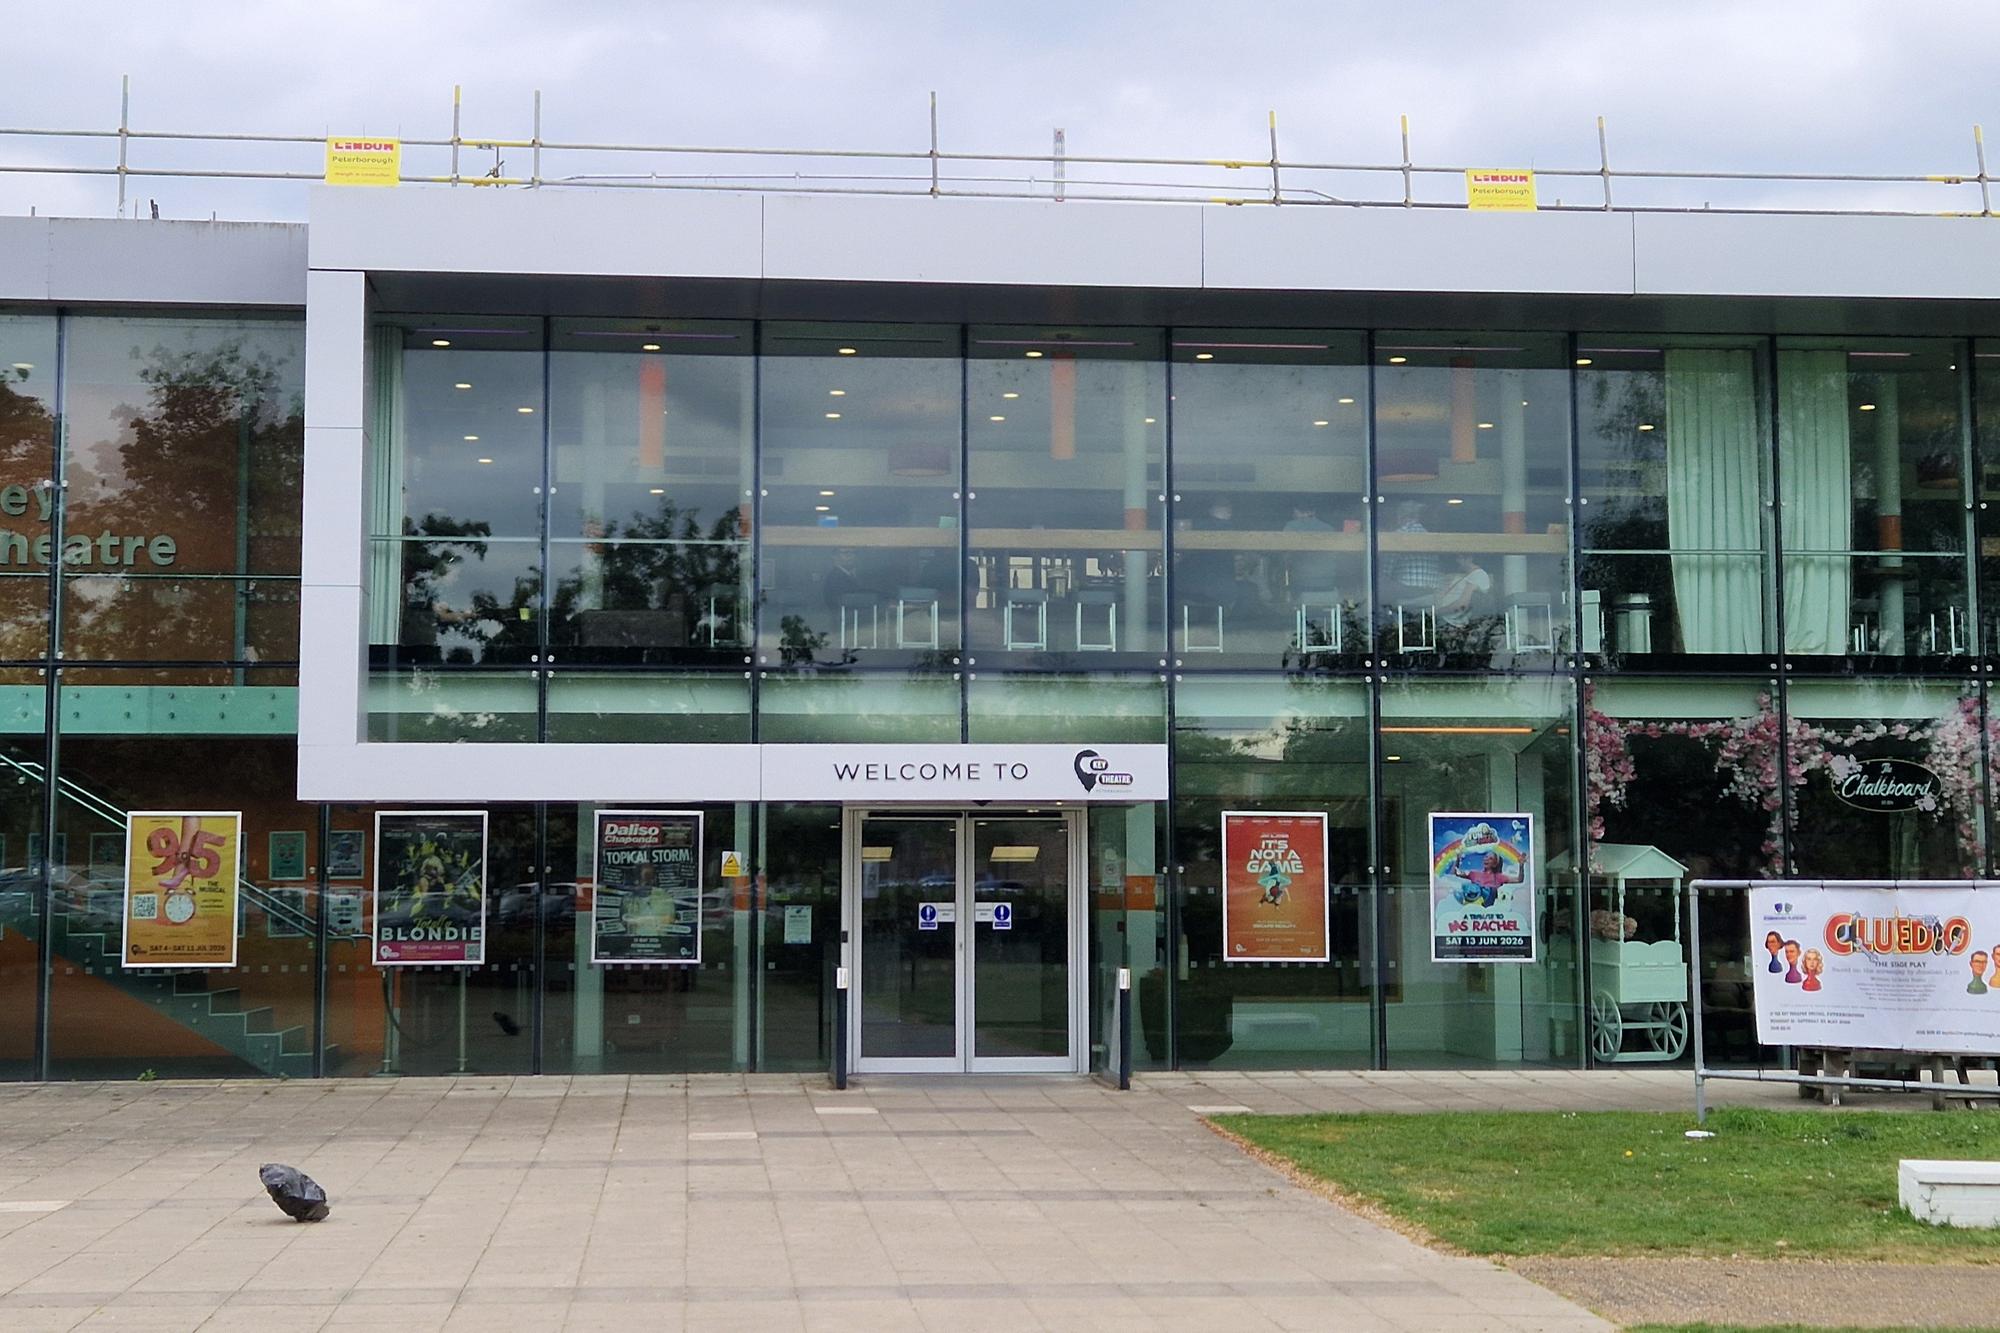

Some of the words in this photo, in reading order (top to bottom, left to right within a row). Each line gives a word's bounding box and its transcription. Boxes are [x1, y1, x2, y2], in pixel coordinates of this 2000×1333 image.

[332, 155, 394, 165] Peterborough
[1472, 187, 1530, 195] Peterborough
[1092, 760, 1107, 770] KEY
[833, 762, 981, 781] WELCOME
[993, 762, 1029, 781] TO
[1101, 774, 1132, 784] THEATRE
[1842, 774, 1933, 798] Chalkboard
[604, 823, 660, 836] Daliso
[604, 835, 659, 844] Chaponda
[1261, 840, 1289, 849] IT'S
[606, 850, 649, 865] TOPICAL
[652, 848, 690, 862] STORM
[1250, 849, 1285, 860] NOT
[1287, 849, 1301, 860] A
[1246, 860, 1304, 873] GAME
[1472, 920, 1520, 932] RACHEL
[381, 927, 481, 940] BLONDIE
[1446, 937, 1463, 945] SAT
[1465, 937, 1476, 945] 13
[1478, 937, 1498, 945] JUN
[1500, 937, 1524, 945] 2026
[1910, 961, 1927, 969] PLAY
